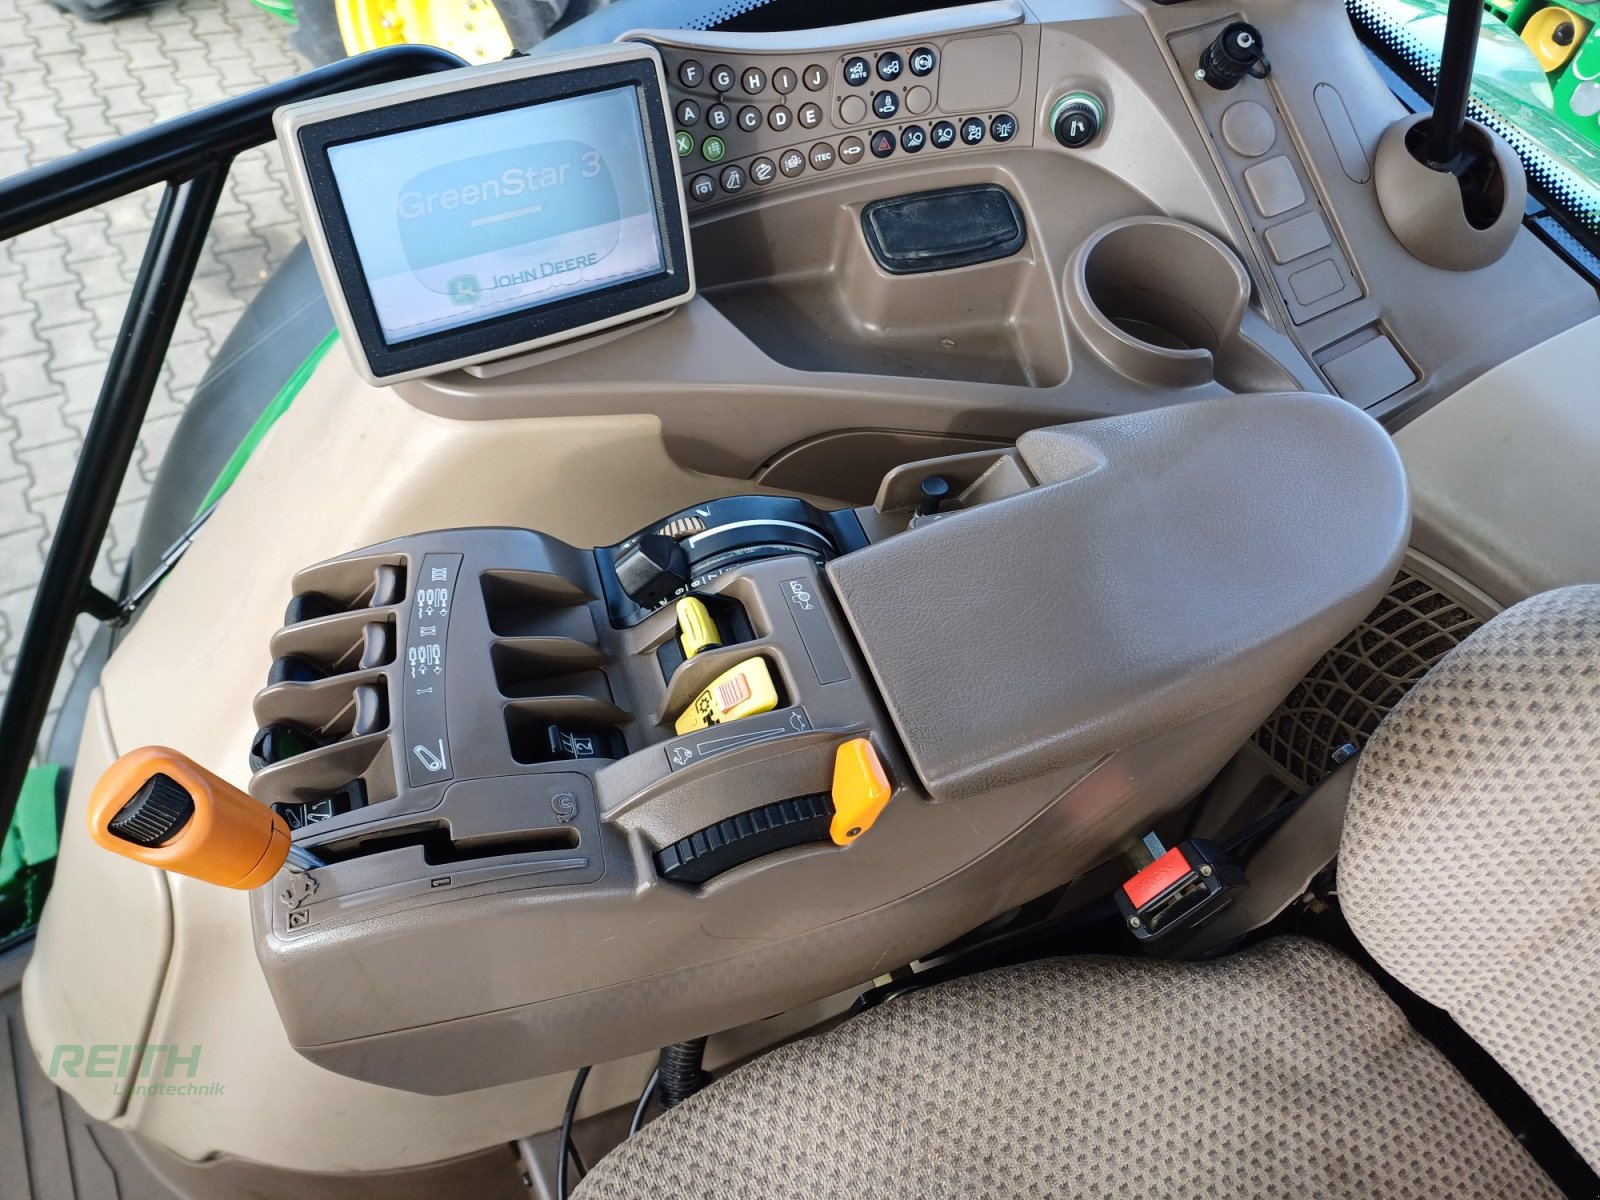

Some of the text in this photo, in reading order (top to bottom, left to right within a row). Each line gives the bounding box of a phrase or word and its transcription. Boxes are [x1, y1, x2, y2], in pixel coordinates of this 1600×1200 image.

[686, 66, 822, 89] F G H I J
[850, 71, 868, 80] AUTO
[684, 106, 817, 126] A B C D E
[400, 150, 602, 220] GreenStar 3
